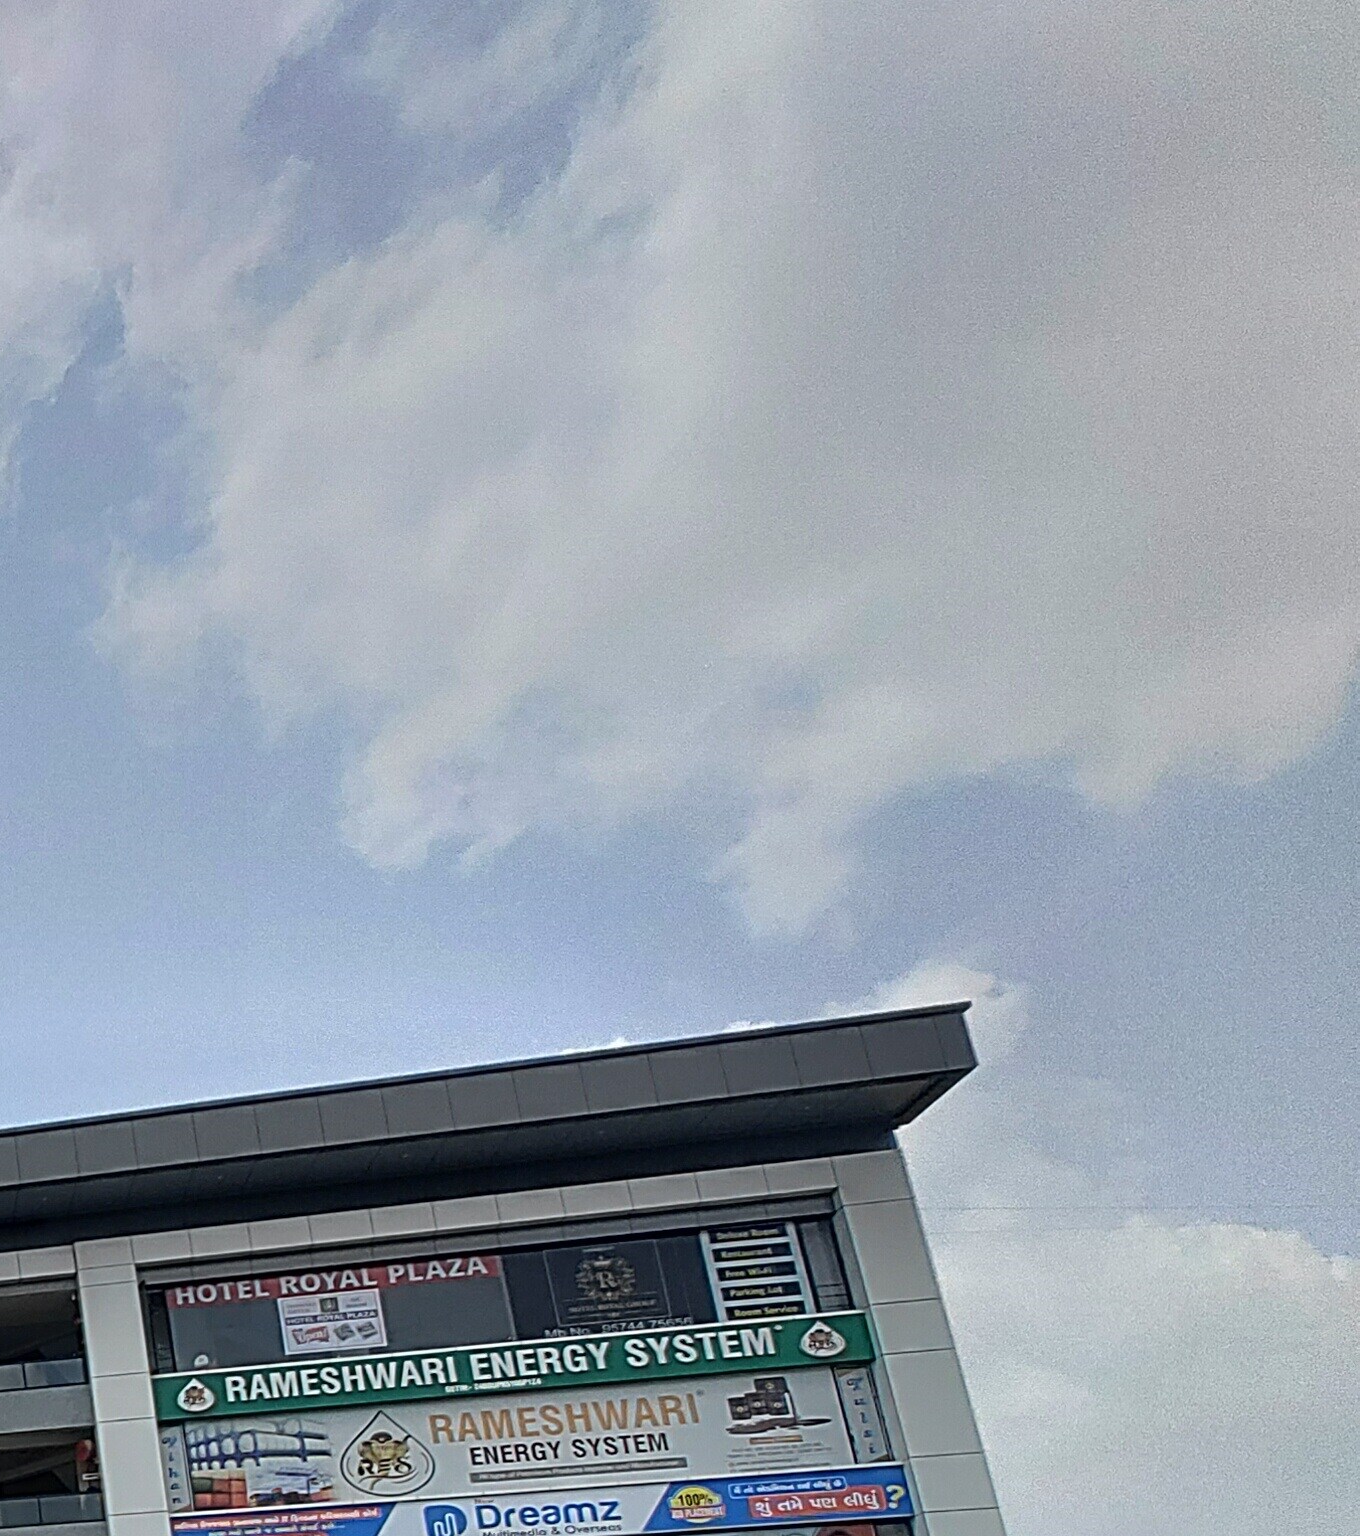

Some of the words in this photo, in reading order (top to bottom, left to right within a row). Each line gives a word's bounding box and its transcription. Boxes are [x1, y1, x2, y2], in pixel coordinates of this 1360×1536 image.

[175, 1279, 270, 1305] HOTEL
[281, 1267, 377, 1295] ROYAL
[388, 1255, 488, 1284] PLAZA
[733, 1306, 762, 1318] Room
[225, 1356, 458, 1402] RAMESHWARI
[470, 1341, 610, 1381] ENERGY
[624, 1326, 776, 1369] SYSTEM
[428, 1391, 701, 1445] RAMESHWARI
[470, 1440, 561, 1466] ENERGY
[572, 1431, 670, 1458] SYSTEM
[678, 1491, 715, 1508] 100%
[754, 1497, 774, 1519] શું
[777, 1495, 805, 1513] તમે
[808, 1497, 839, 1513] પણ
[843, 1489, 881, 1511] લીધું
[475, 1500, 622, 1530] Dreamz
[551, 1526, 562, 1535] &
[565, 1523, 622, 1534] Overseas
